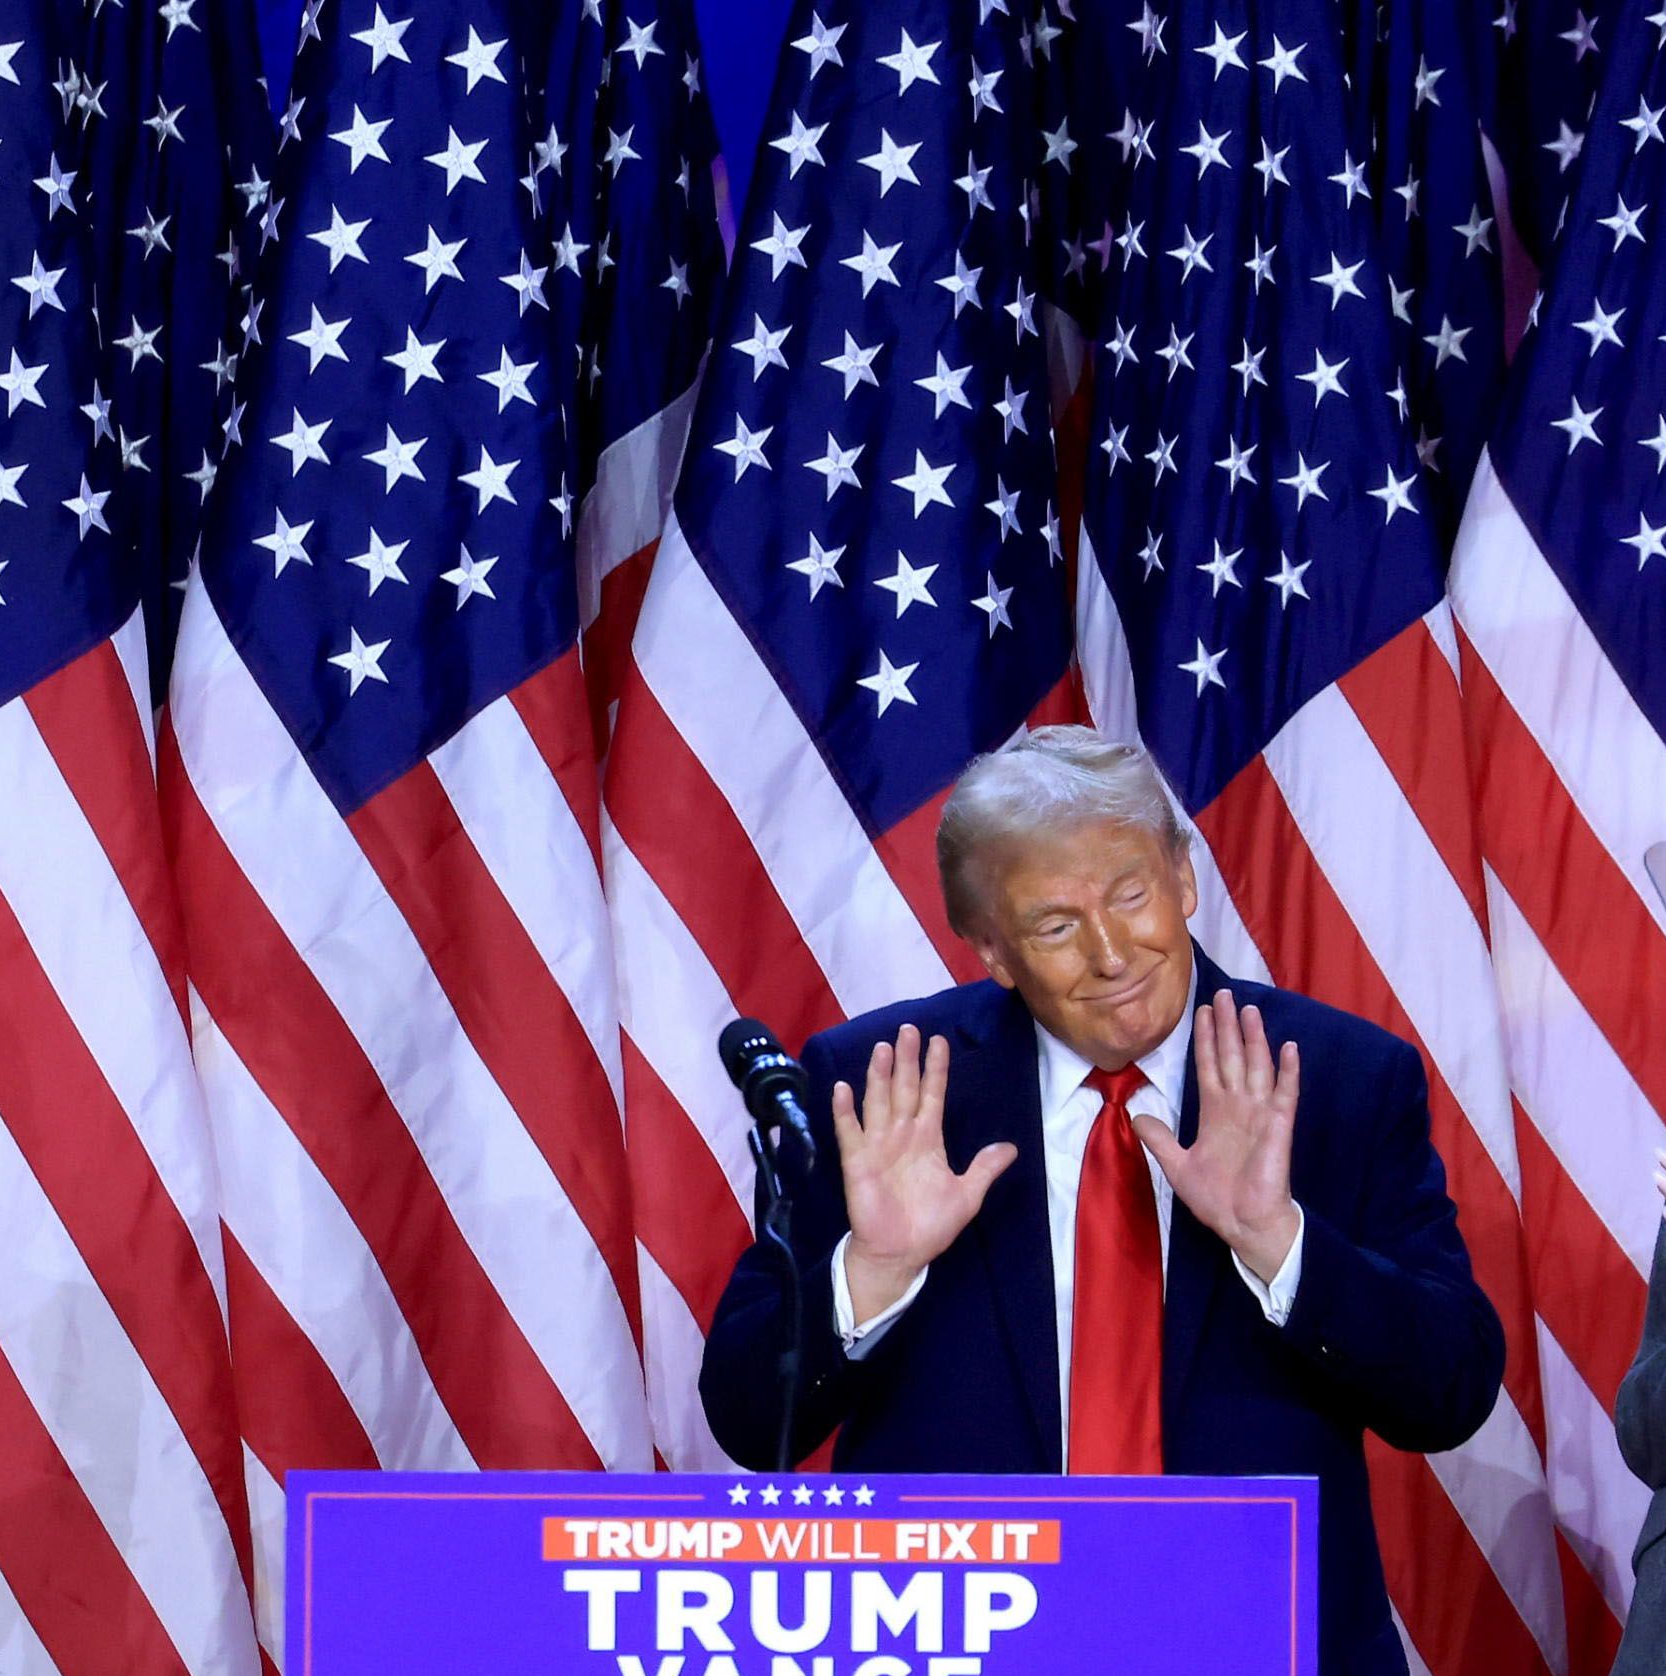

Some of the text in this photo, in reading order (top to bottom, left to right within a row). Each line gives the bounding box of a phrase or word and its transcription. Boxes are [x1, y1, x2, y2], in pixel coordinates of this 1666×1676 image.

[563, 1520, 1038, 1561] TRUMP WILL FIX IT
[562, 1568, 1039, 1653] TRUMP
